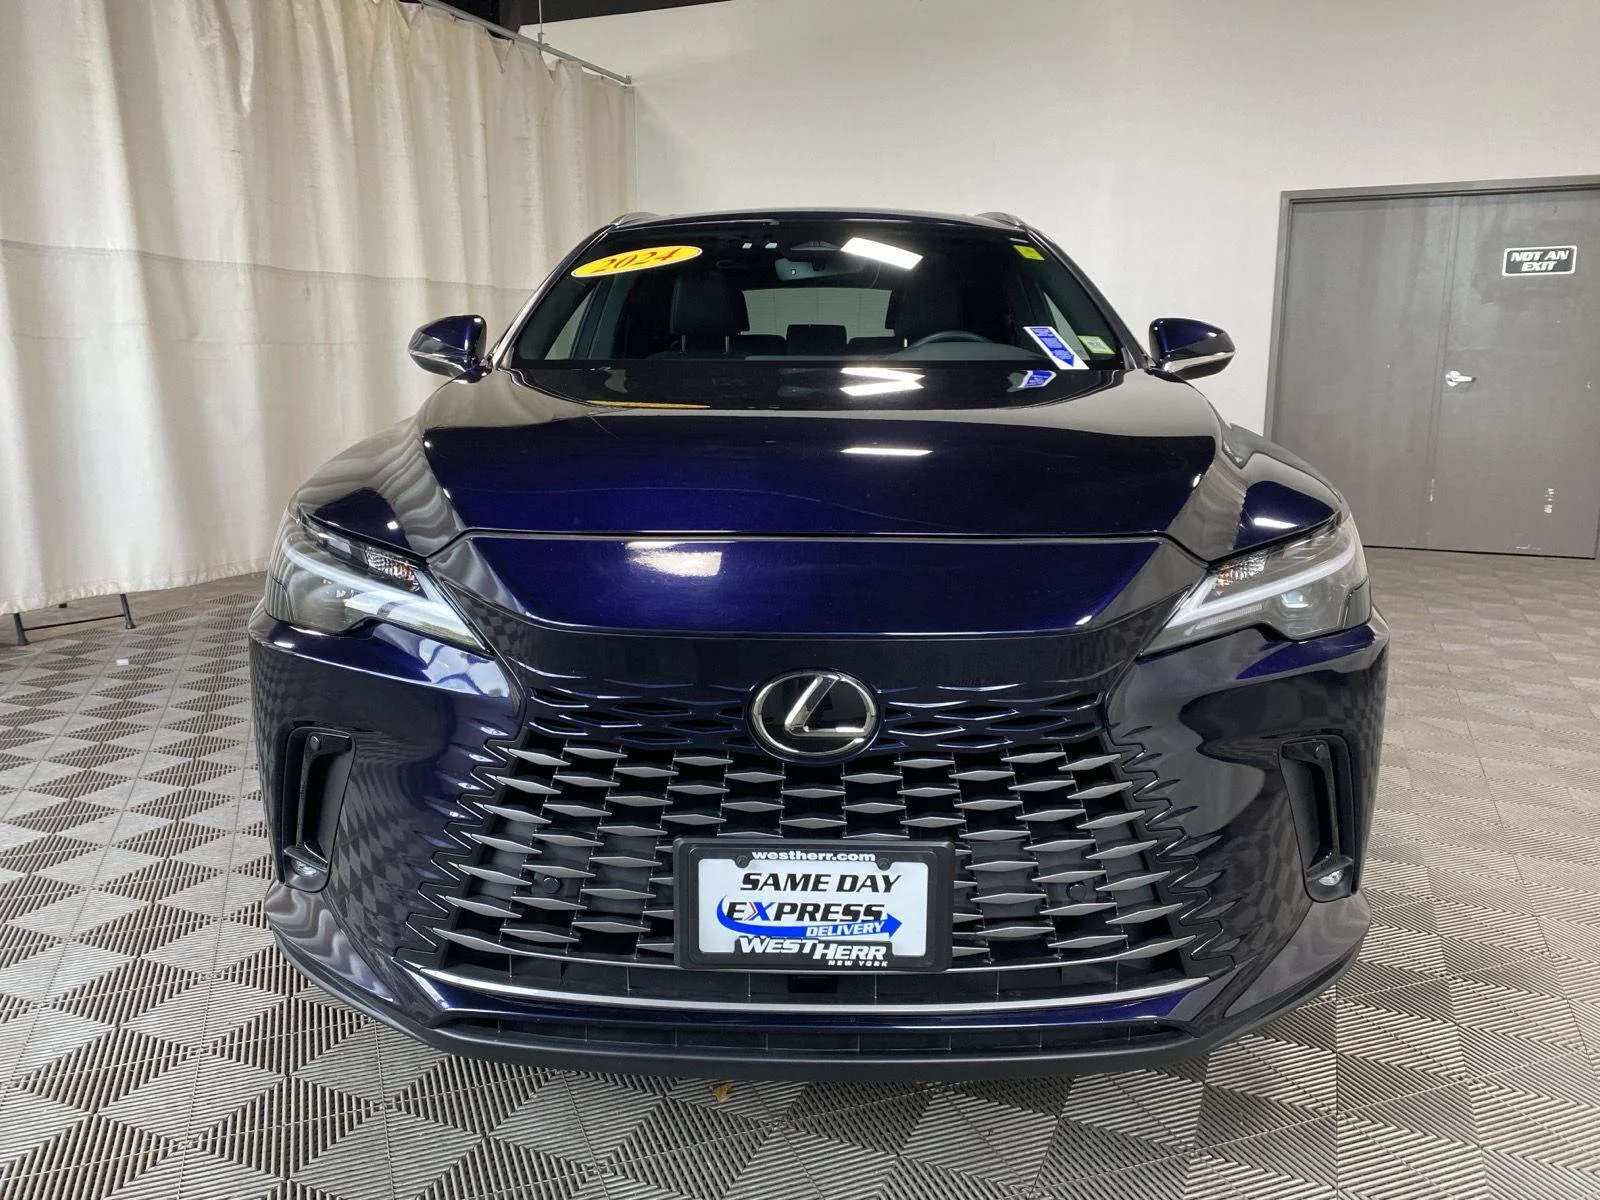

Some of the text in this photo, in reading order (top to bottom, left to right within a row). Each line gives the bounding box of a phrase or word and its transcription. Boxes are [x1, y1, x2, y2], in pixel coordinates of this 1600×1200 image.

[591, 248, 681, 273] 2024
[1511, 250, 1569, 262] NOT AN
[1522, 261, 1557, 271] EXIT
[752, 851, 876, 862] westherr.com
[740, 872, 902, 893] SAME DAY
[727, 901, 885, 922] EXPRESS
[805, 922, 885, 938] DELIVERY
